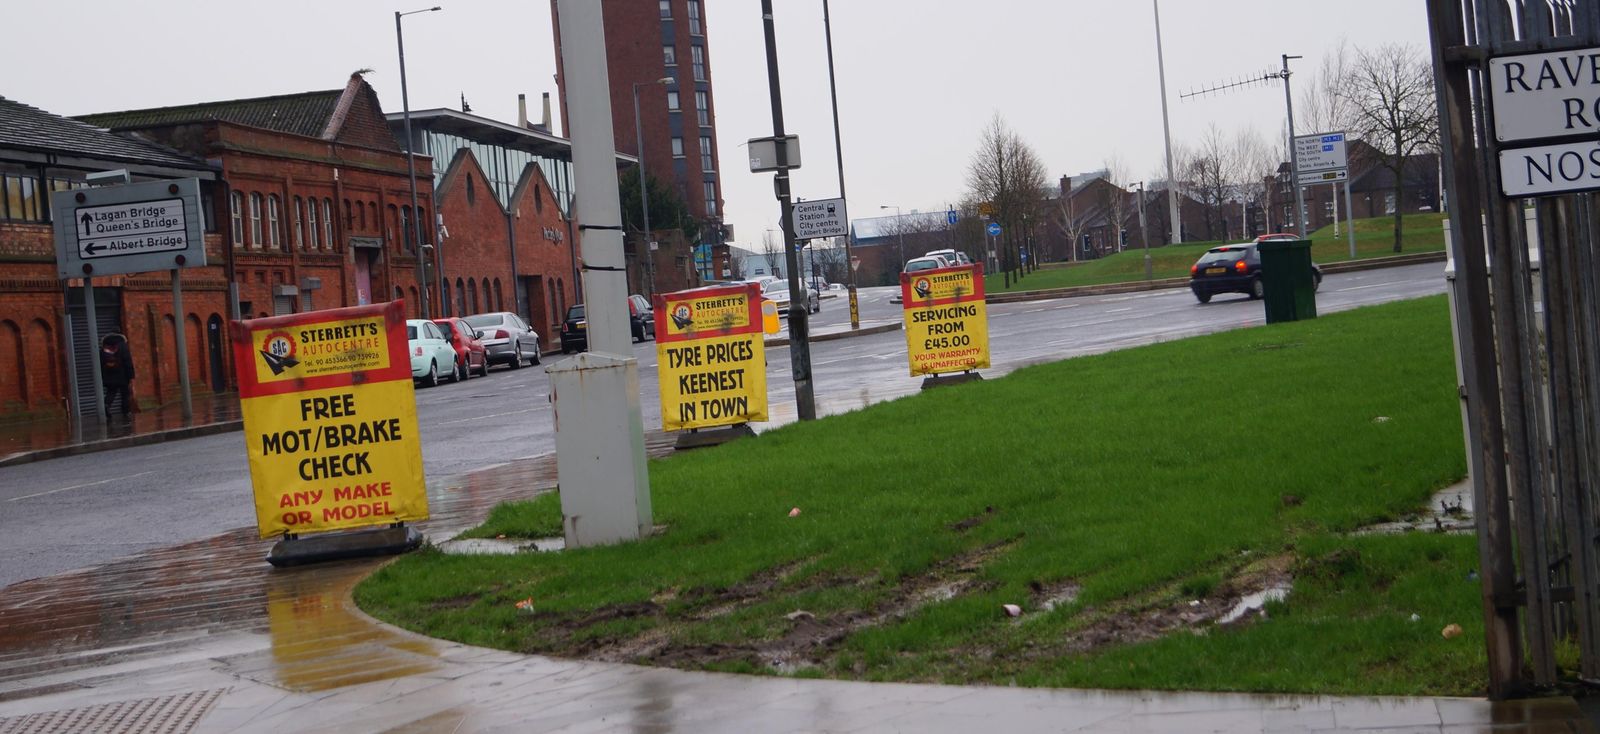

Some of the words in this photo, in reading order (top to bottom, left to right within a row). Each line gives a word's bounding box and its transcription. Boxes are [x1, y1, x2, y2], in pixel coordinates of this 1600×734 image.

[1561, 97, 1600, 129] R
[94, 210, 127, 222] Lagan
[130, 206, 166, 218] Bridge
[798, 204, 824, 213] Central
[96, 220, 140, 233] Queen's
[142, 217, 178, 229] Bridge
[799, 213, 825, 221] Station
[800, 229, 821, 237] (Albert
[822, 226, 845, 234] Bridge)
[109, 238, 144, 250] Albert
[147, 235, 183, 247] Bridge
[933, 272, 970, 284] STERRETT'S
[695, 297, 744, 310] STERRETT'S
[912, 305, 977, 323] SERVICING
[300, 322, 378, 343] STERRETT'S
[928, 321, 964, 335] FROM
[272, 340, 287, 355] SAC
[303, 337, 380, 356] AUTOCENTRE
[925, 335, 970, 350] £45.00
[667, 346, 702, 368] TYRE
[706, 340, 753, 365] PRICES
[914, 353, 937, 362] YOUR
[938, 347, 980, 360] WARRANTY
[930, 357, 976, 369] UNAFFECTED
[679, 369, 745, 395] KEENEST
[300, 393, 356, 421] FREE
[680, 401, 696, 422] IN
[701, 396, 748, 420] TOWN
[262, 418, 402, 456] MOT/BRAKE
[298, 451, 373, 481] CHECK
[279, 489, 323, 508] ANY
[333, 482, 393, 501] MAKE
[282, 510, 313, 526] OR
[323, 501, 396, 522] MODEL
